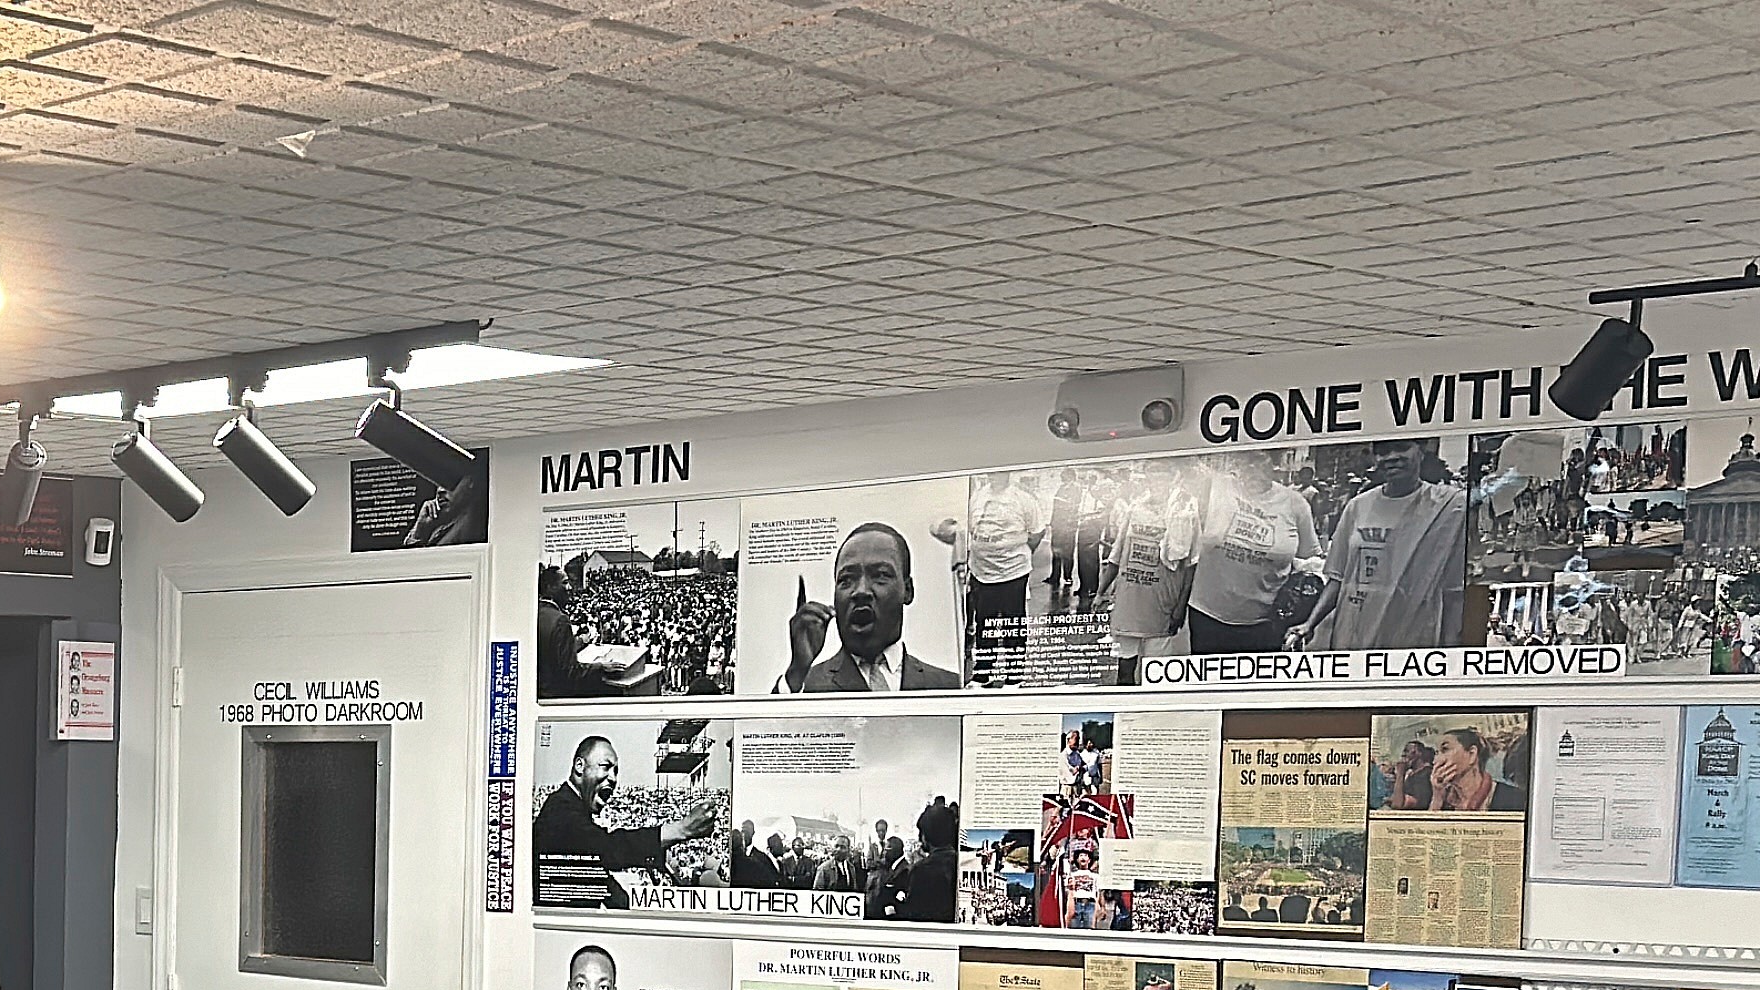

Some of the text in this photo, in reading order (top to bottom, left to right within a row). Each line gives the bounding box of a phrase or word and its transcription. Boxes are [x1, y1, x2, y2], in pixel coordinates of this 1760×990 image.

[1199, 382, 1363, 444] GONE
[1384, 366, 1542, 428] WITH
[1560, 354, 1687, 412] HE
[541, 441, 691, 494] MARTIN
[985, 613, 1109, 627] MYRTLE BEACH PROTEST TO
[982, 628, 1018, 638] REMOVE
[1020, 626, 1084, 636] CONFEDERATE
[1145, 653, 1349, 685] CONFEDERATE
[1365, 650, 1447, 678] FLAG
[1463, 645, 1621, 675] REMOVED
[503, 675, 510, 684] IS
[253, 680, 380, 700] CECIL WILLIAMS
[220, 702, 424, 722] 1968 PHOTO DARKROOM
[493, 646, 504, 775] JUSTICE EVERYWHERE
[507, 646, 517, 775] INJUSTICE ANYWHERE
[502, 732, 508, 744] TO
[1231, 749, 1360, 768] The flag comes down;
[1240, 769, 1350, 786] SC moves forward
[488, 782, 500, 910] WORK FOR JUSTICE
[501, 782, 513, 910] IF YOU WANT PEACE
[631, 886, 861, 917] MARTIN LUTHER KING
[790, 949, 901, 964] POWERFUL WORDS
[759, 962, 934, 983] DR. MARTIN LUTHER JR.
[1252, 962, 1327, 978] Witness to history
